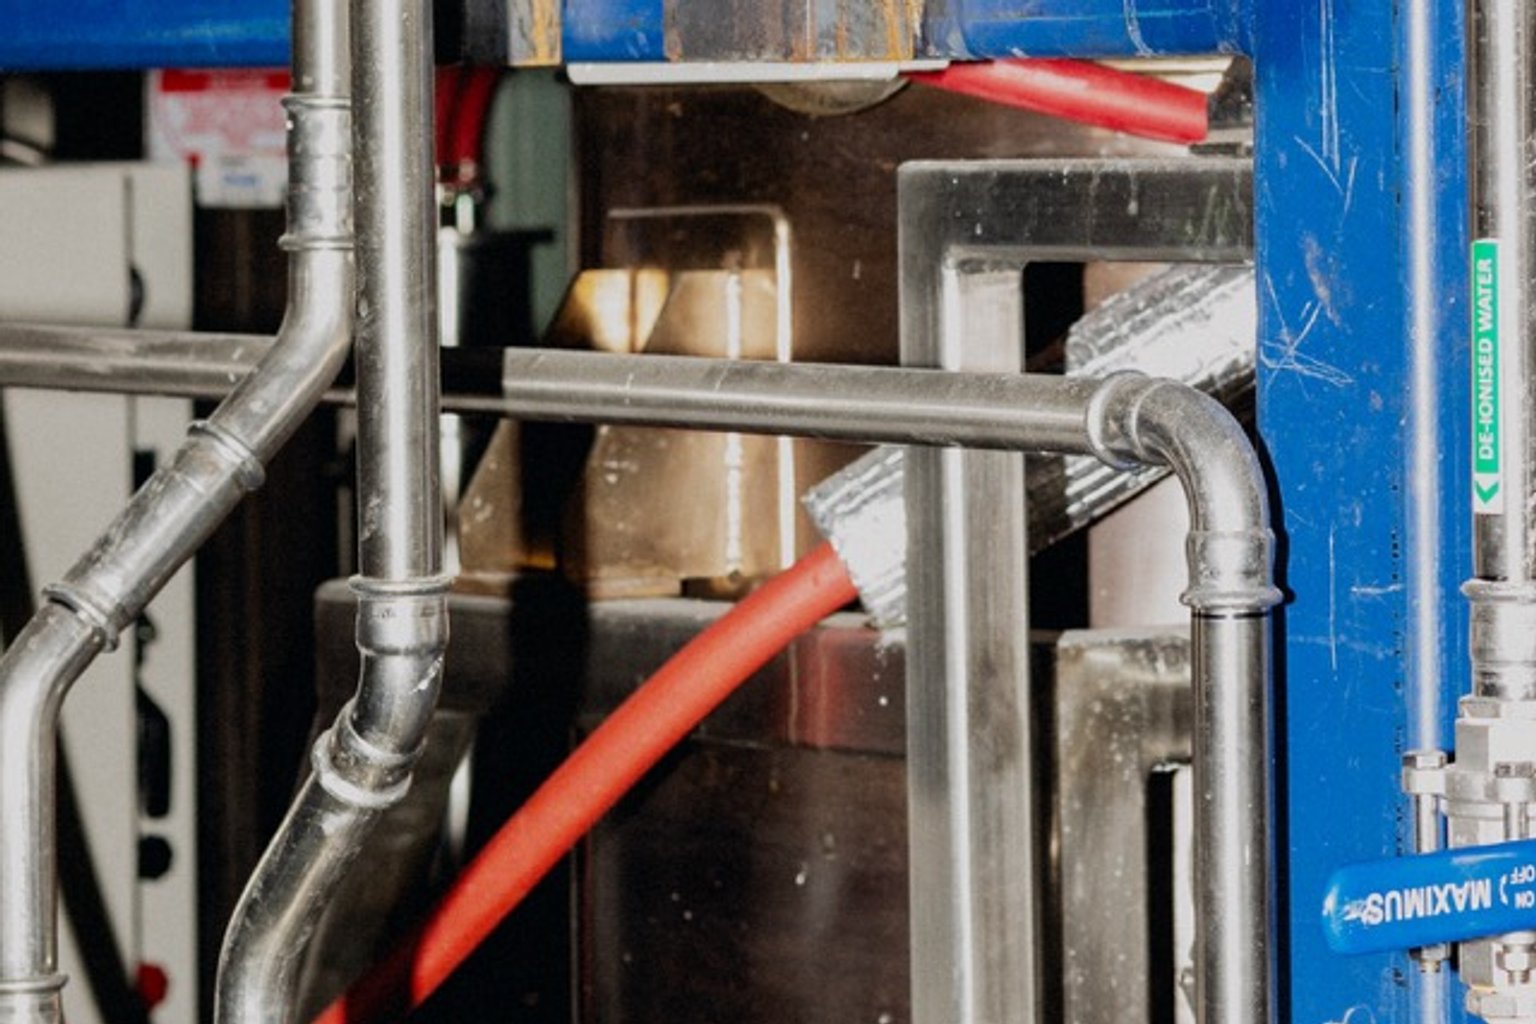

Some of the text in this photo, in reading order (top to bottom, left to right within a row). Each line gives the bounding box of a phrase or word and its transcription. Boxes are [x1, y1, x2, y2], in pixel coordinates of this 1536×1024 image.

[1476, 258, 1495, 461] DE-IONISED WATER
[1509, 864, 1536, 885] OFF
[1363, 878, 1492, 926] MAXIMUS
[1514, 889, 1536, 909] ON
